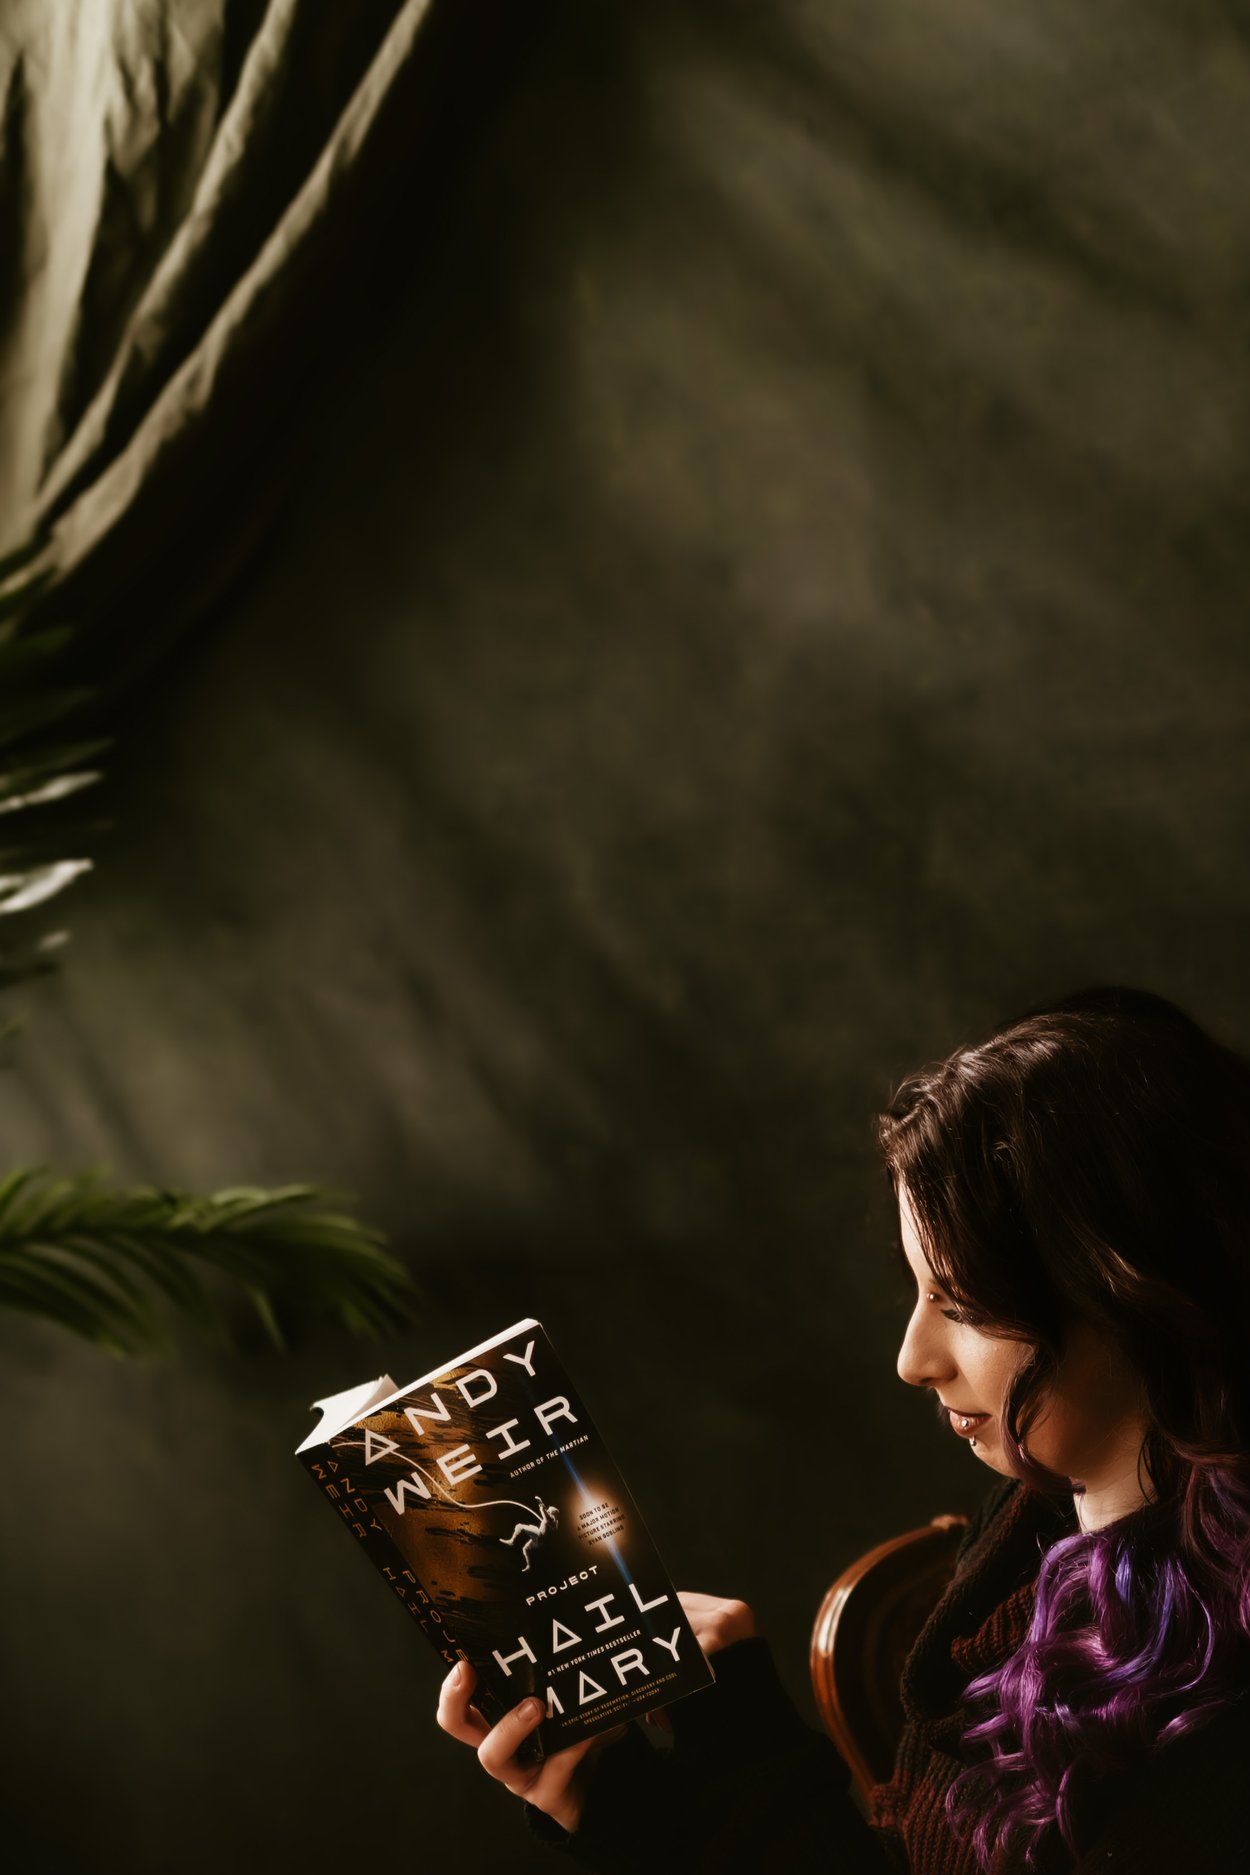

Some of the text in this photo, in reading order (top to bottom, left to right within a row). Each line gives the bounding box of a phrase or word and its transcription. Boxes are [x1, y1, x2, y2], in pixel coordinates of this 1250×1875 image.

[365, 1340, 536, 1466] ANDY
[383, 1395, 579, 1516] WEIR
[509, 1434, 589, 1478] AUTHOR OF THE MARTIAN
[311, 1463, 367, 1538] WEIR
[327, 1459, 382, 1531] ANDY
[579, 1510, 594, 1520] SOON
[602, 1502, 609, 1510] BE
[581, 1517, 600, 1530] MAJOR
[599, 1507, 620, 1521] MOTION
[578, 1514, 625, 1541] PICTURE STARRING
[588, 1524, 624, 1546] RYAN GOSLING
[382, 1566, 429, 1633] HAIL
[526, 1565, 600, 1606] PROJECT
[491, 1582, 669, 1677] HAIL
[547, 1629, 641, 1677] #1 NEW YORK TIMES BESTSELLER
